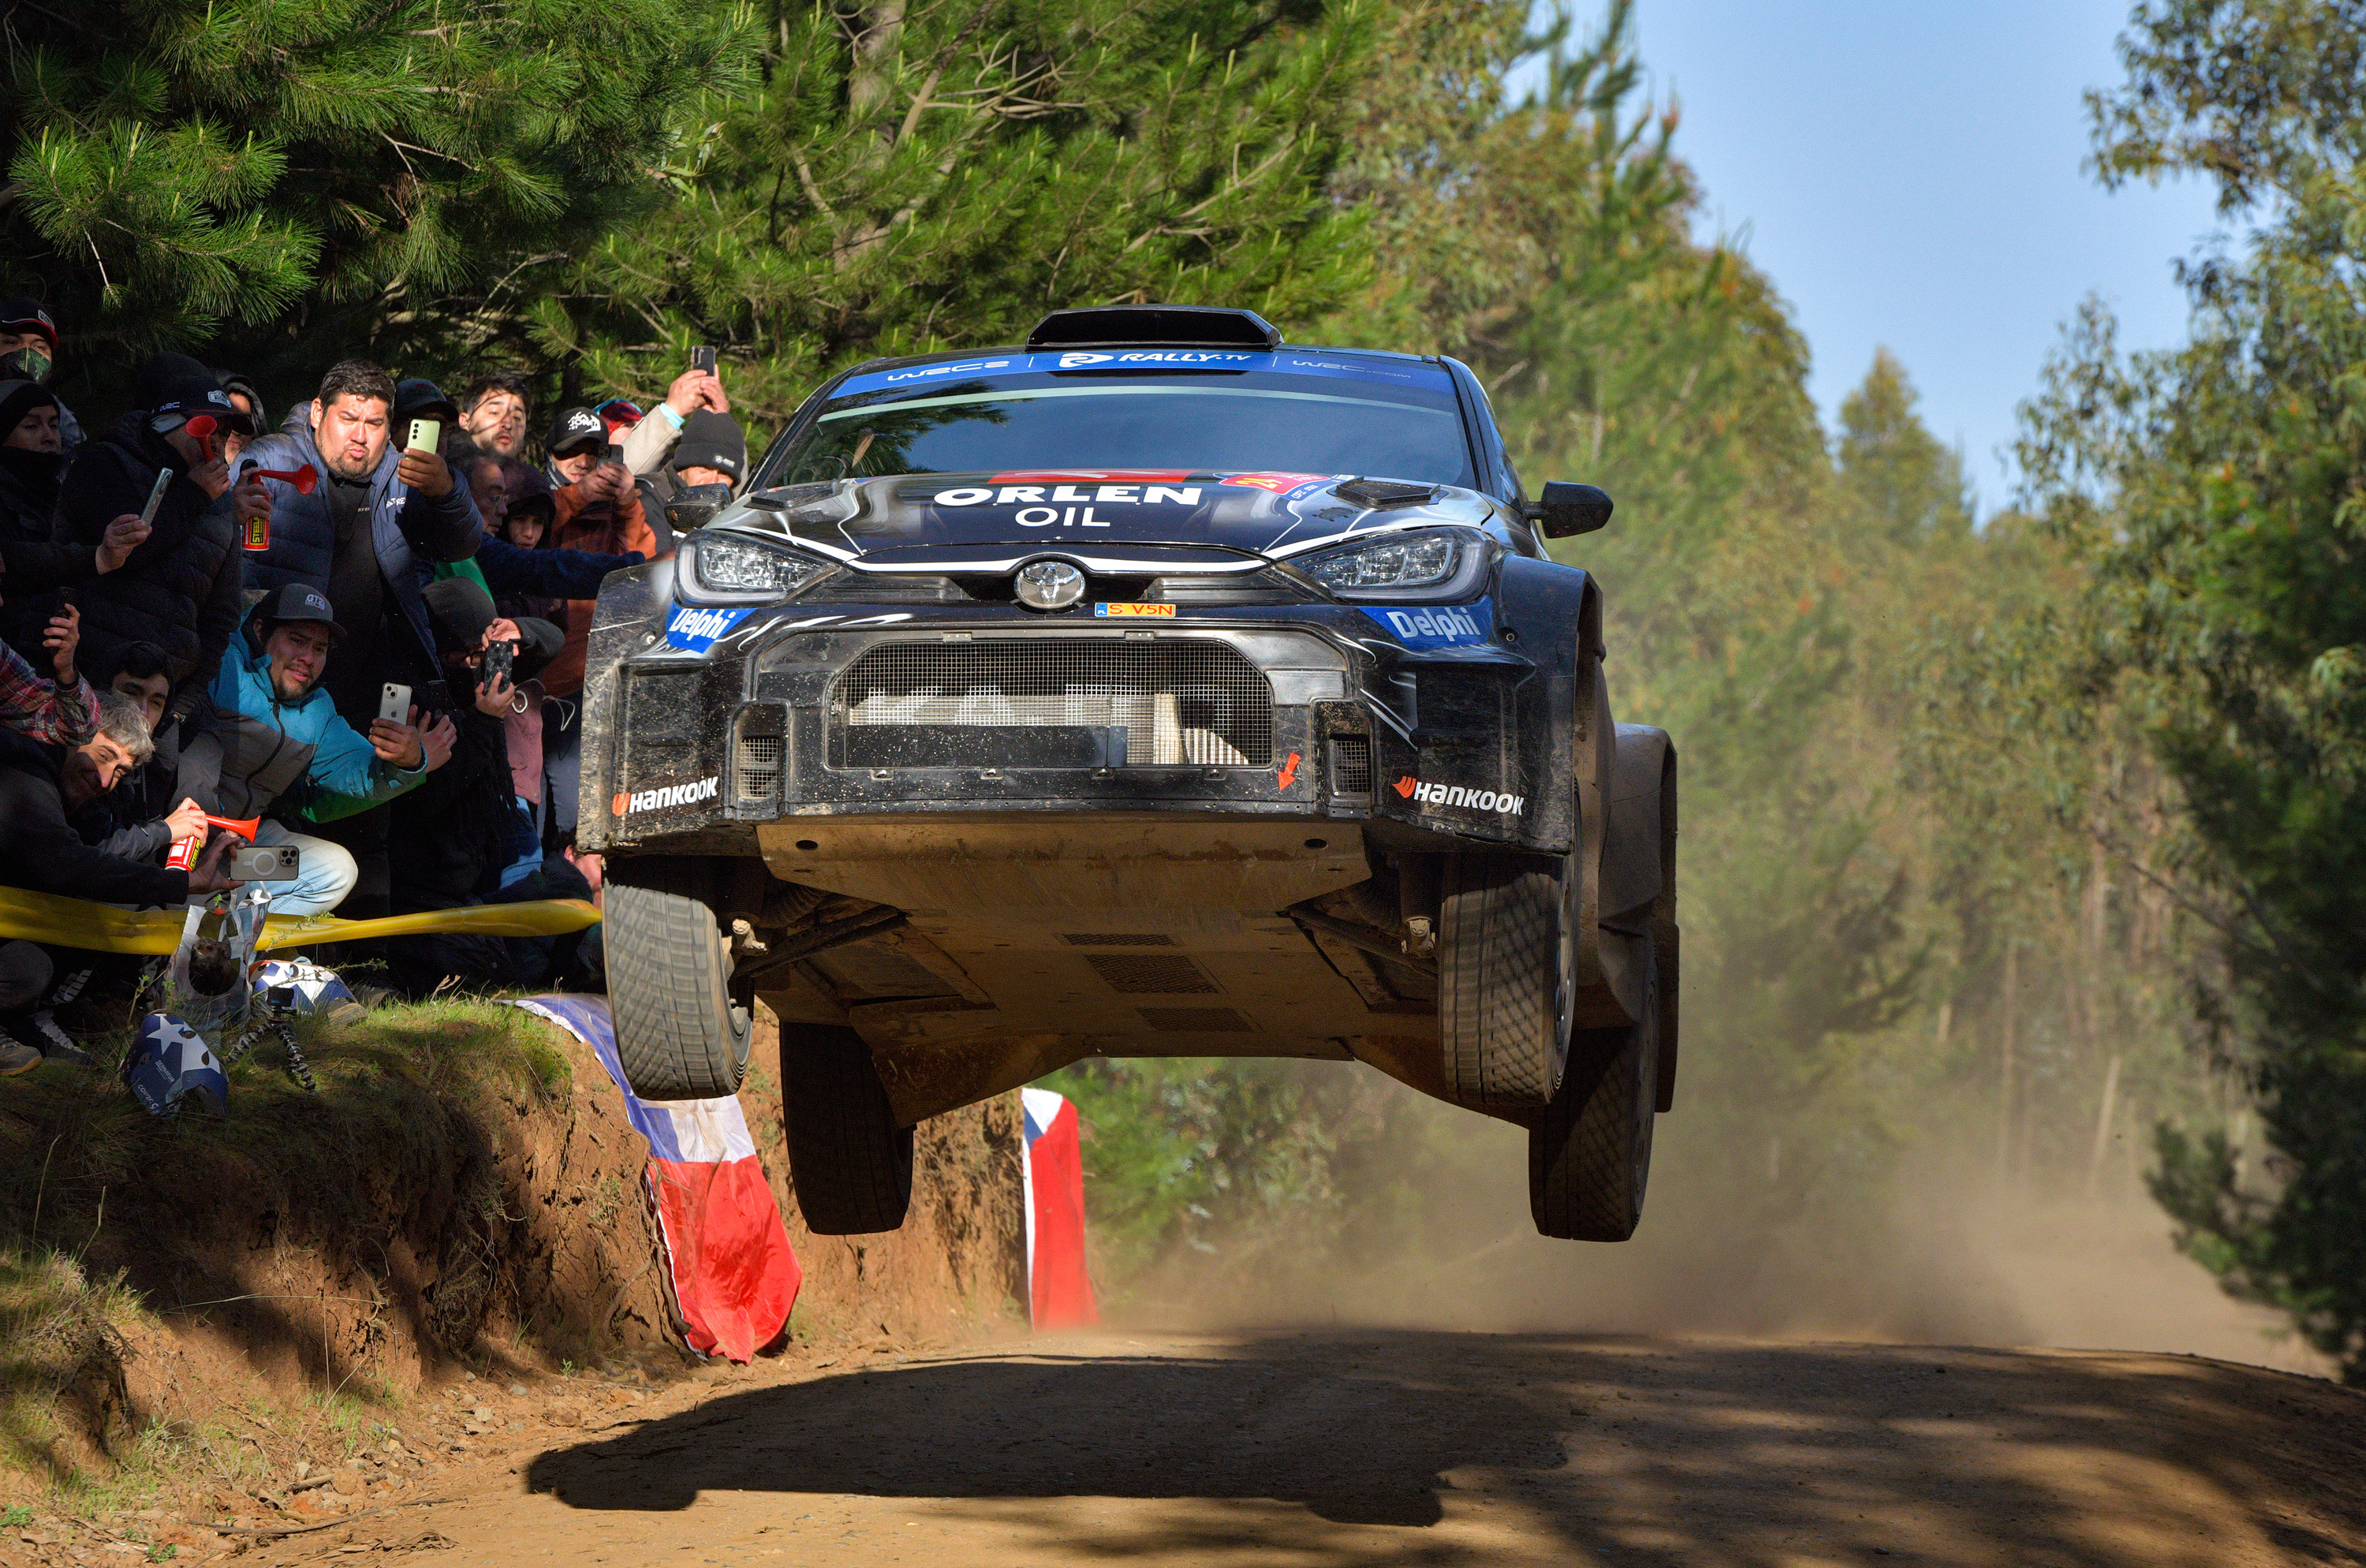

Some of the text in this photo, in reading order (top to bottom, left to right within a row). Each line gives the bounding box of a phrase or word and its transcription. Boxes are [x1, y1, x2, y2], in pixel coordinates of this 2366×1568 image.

[887, 360, 1009, 381] WRC2
[159, 401, 181, 411] WRC
[934, 485, 1203, 506] ORLEN
[1015, 507, 1110, 528] OIL
[1132, 604, 1173, 615] V5N
[668, 608, 737, 641] Delphi
[1386, 607, 1481, 642] Delphi
